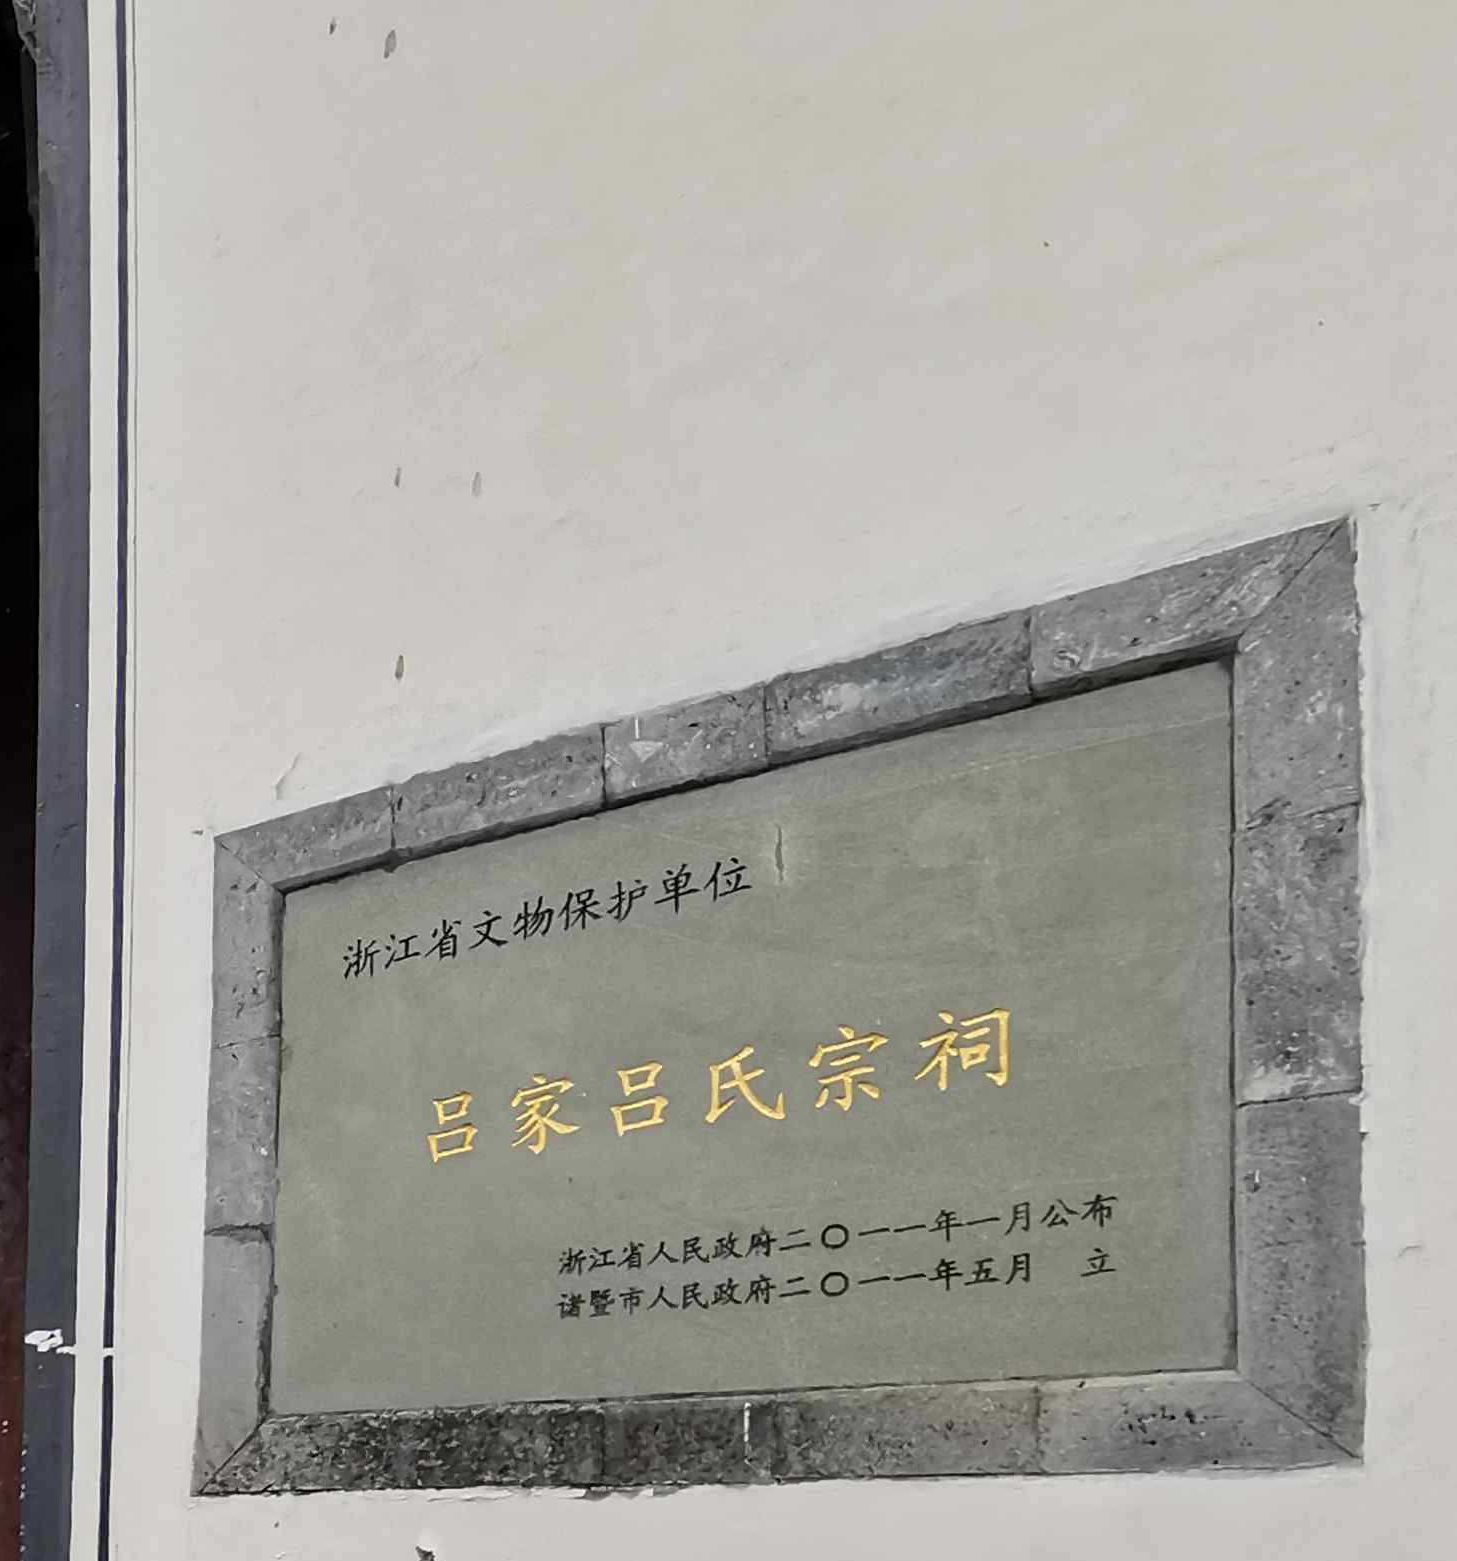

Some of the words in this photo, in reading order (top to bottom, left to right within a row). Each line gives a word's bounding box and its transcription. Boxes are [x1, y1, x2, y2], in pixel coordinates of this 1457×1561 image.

[341, 857, 752, 980] 浙江省文物保护单位
[426, 1007, 1012, 1163] 吕家吕氏宗祠
[1080, 1247, 1118, 1277] 立
